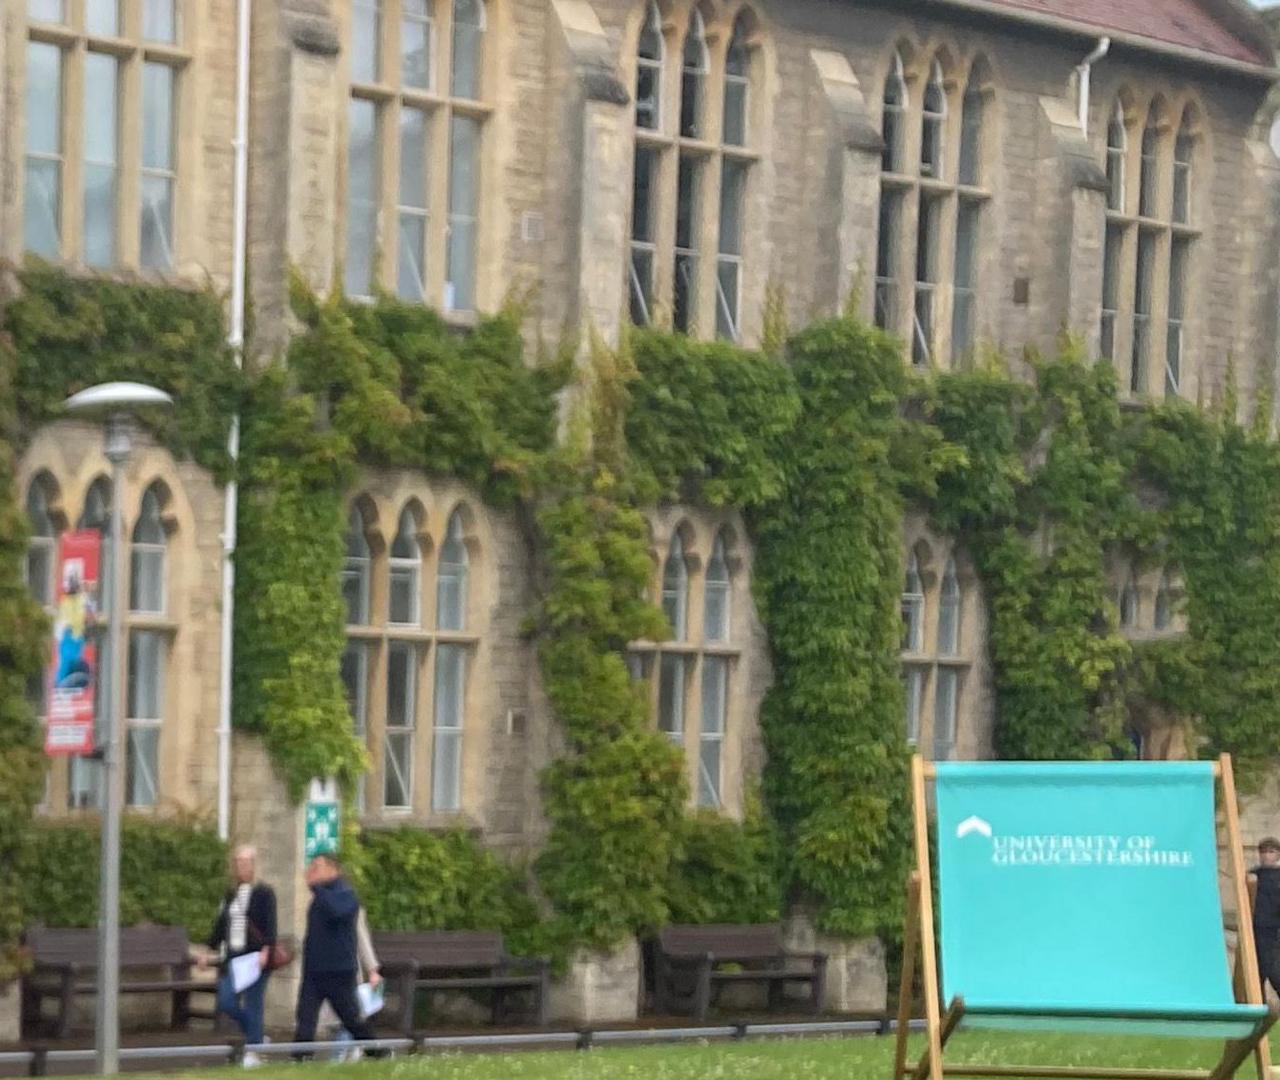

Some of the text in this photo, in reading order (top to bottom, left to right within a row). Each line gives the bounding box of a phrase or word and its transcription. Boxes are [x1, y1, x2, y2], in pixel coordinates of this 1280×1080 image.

[993, 835, 1155, 850] UNIVERSITY OF
[992, 849, 1193, 866] GLOUCESTERSHIRE
